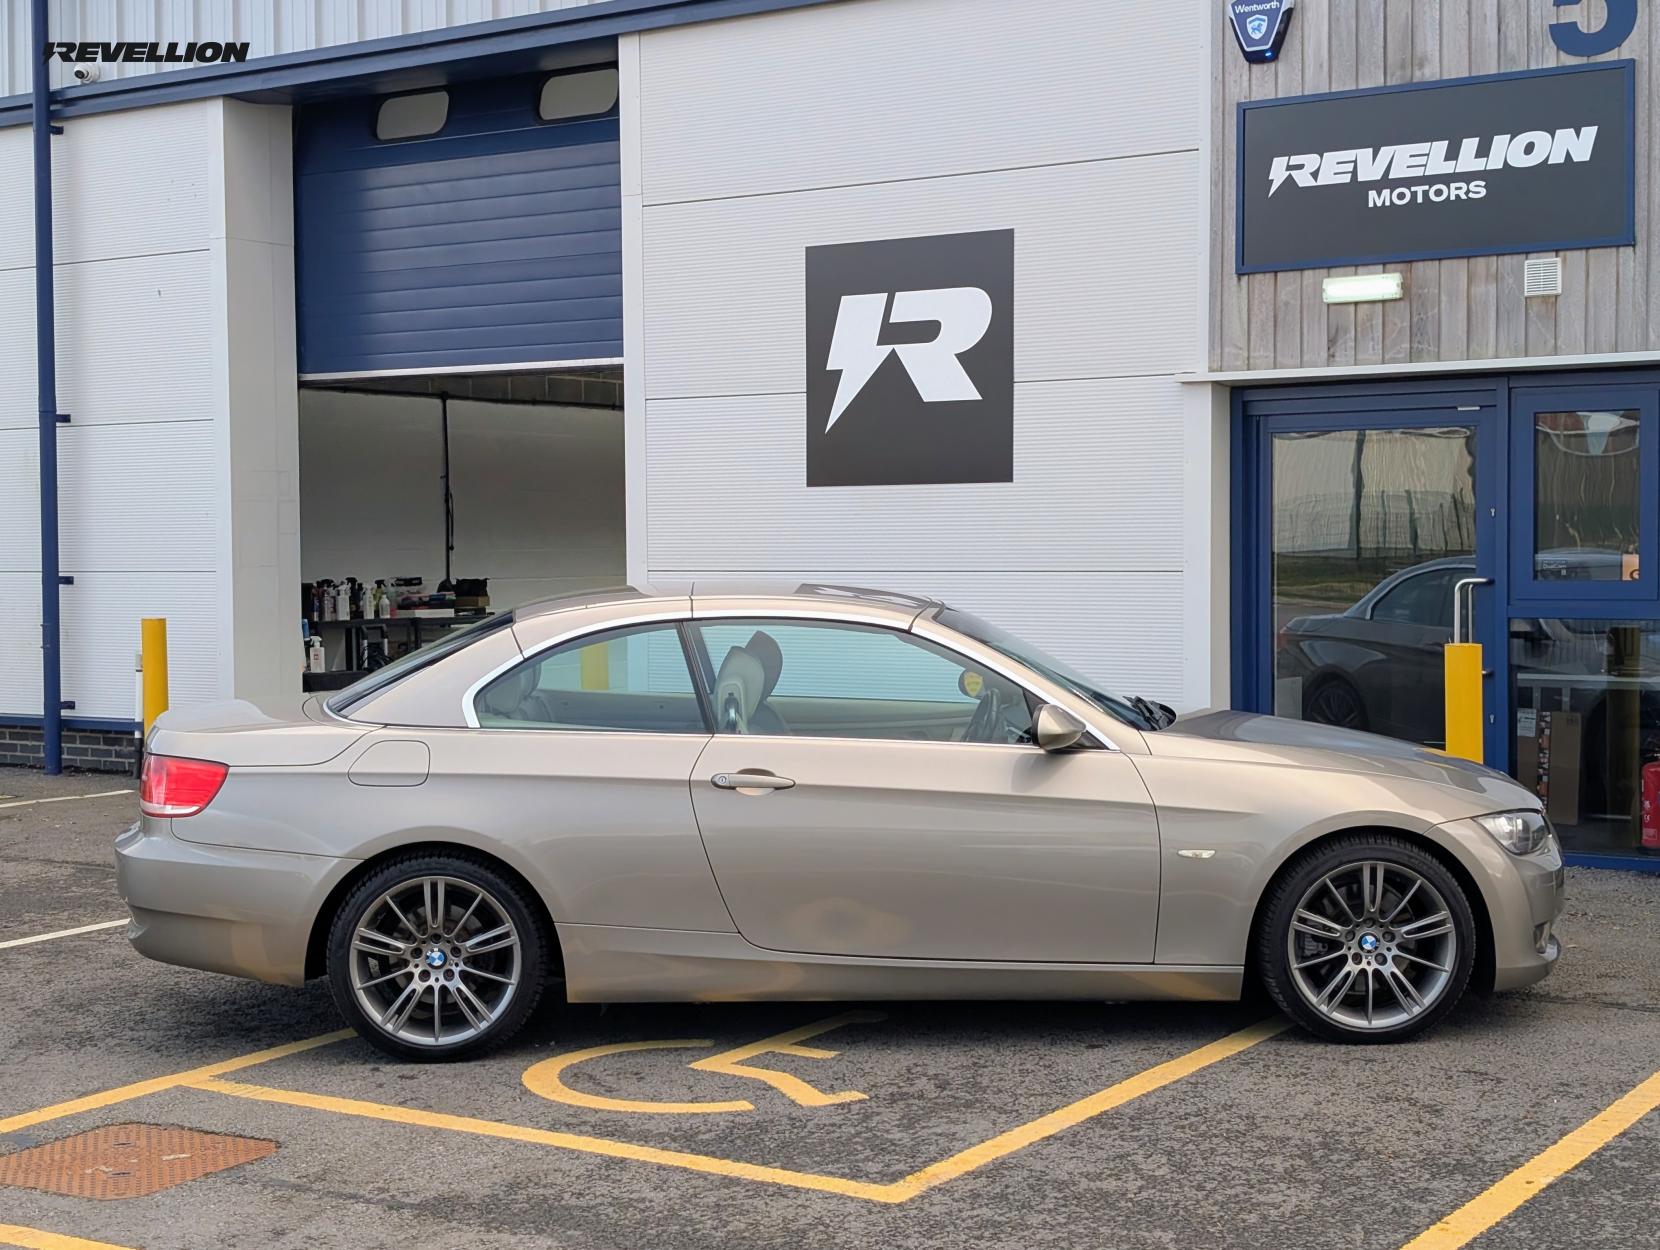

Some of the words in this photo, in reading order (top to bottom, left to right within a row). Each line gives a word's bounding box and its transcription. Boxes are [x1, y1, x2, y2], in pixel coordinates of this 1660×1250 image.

[1235, 0, 1280, 14] Wentworth
[1268, 126, 1598, 199] REVELLION
[1368, 180, 1487, 208] MOTORS
[825, 286, 993, 434] R
